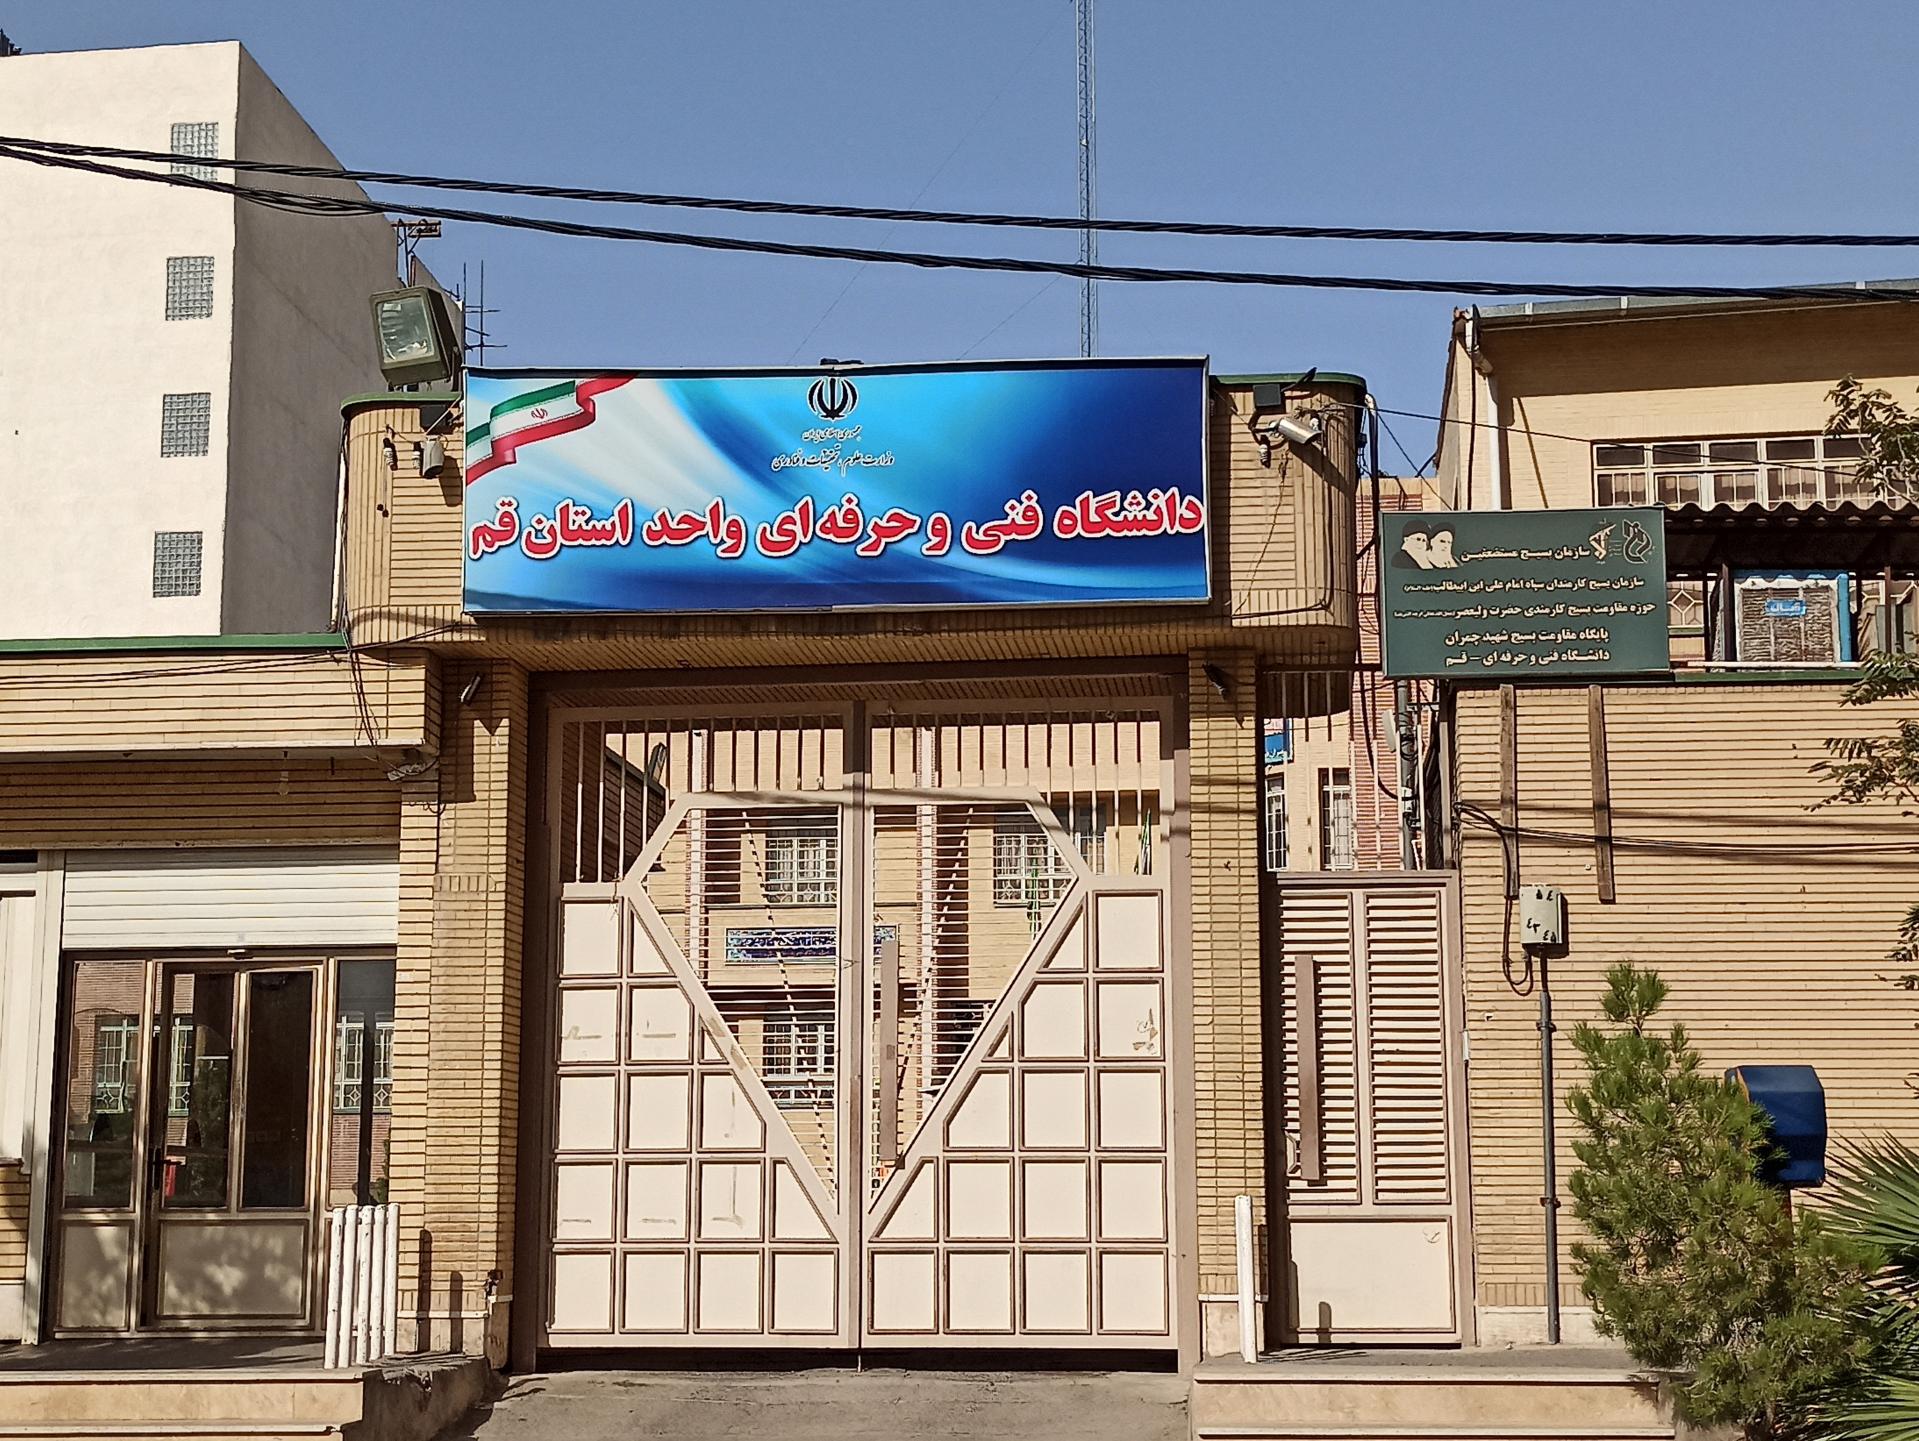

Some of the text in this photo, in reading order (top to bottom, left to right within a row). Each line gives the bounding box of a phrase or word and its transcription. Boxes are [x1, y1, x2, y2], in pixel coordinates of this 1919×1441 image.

[1055, 489, 1203, 537] دانشگاه
[470, 498, 519, 557] قم
[523, 498, 633, 557] استان
[643, 498, 745, 556] واحد
[964, 492, 1041, 551] فنی
[924, 514, 950, 553] و
[1460, 545, 1590, 562] سازمان بسیج مستضعفین
[1485, 580, 1503, 592] علی
[1505, 579, 1524, 592] امام
[1525, 578, 1544, 591] سپاه
[1546, 578, 1587, 591] کارمندان
[1588, 579, 1611, 590] بسیج
[1611, 576, 1644, 588] سازمان
[1489, 604, 1521, 617] حضرت
[1524, 604, 1565, 617] کارمندی
[1567, 605, 1591, 616] بسیج
[1592, 602, 1628, 615] مقاومت
[1629, 602, 1656, 615] حوزه
[1445, 627, 1609, 645] پایگاه مقاومت بسیج شهید چمران
[1445, 651, 1468, 667] قم
[1538, 649, 1559, 665] فنی
[1561, 649, 1610, 661] دانشگاه
